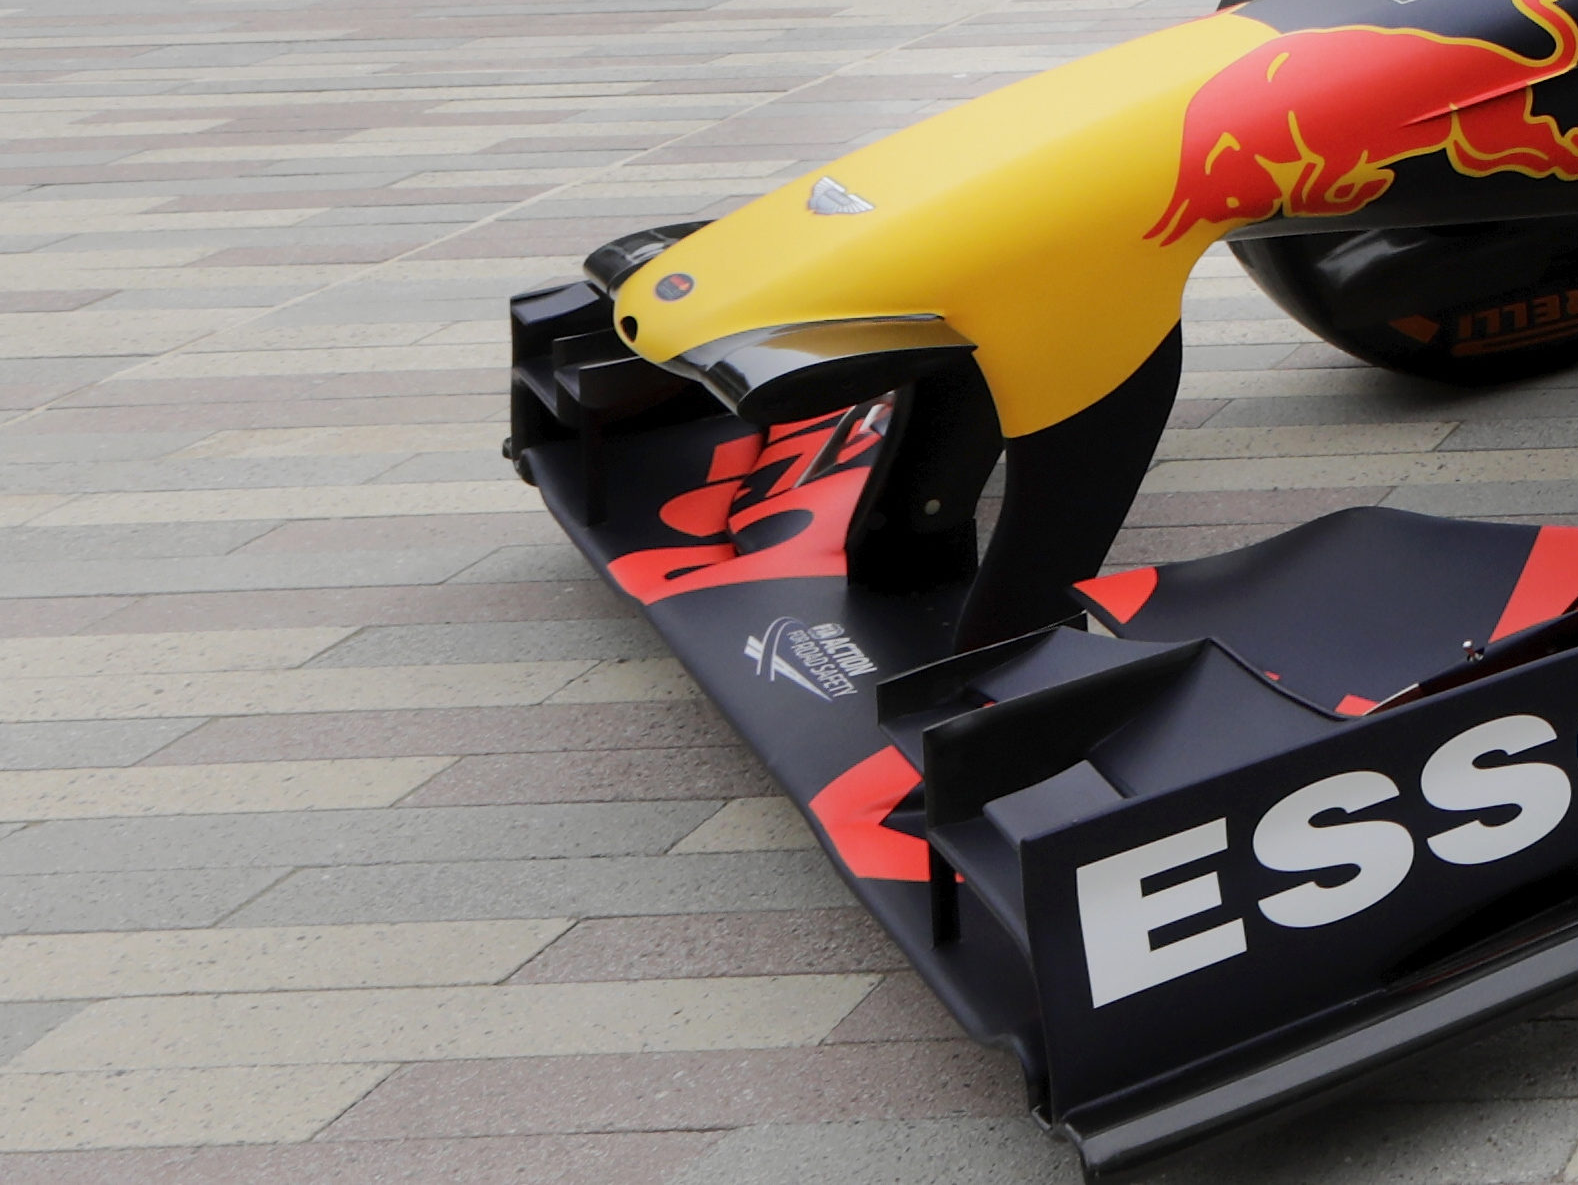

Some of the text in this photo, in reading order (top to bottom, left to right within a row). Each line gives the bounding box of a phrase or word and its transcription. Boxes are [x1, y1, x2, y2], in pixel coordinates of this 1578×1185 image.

[792, 641, 829, 667] ROAD
[820, 637, 878, 677] ACTION
[810, 664, 858, 697] SAFETY
